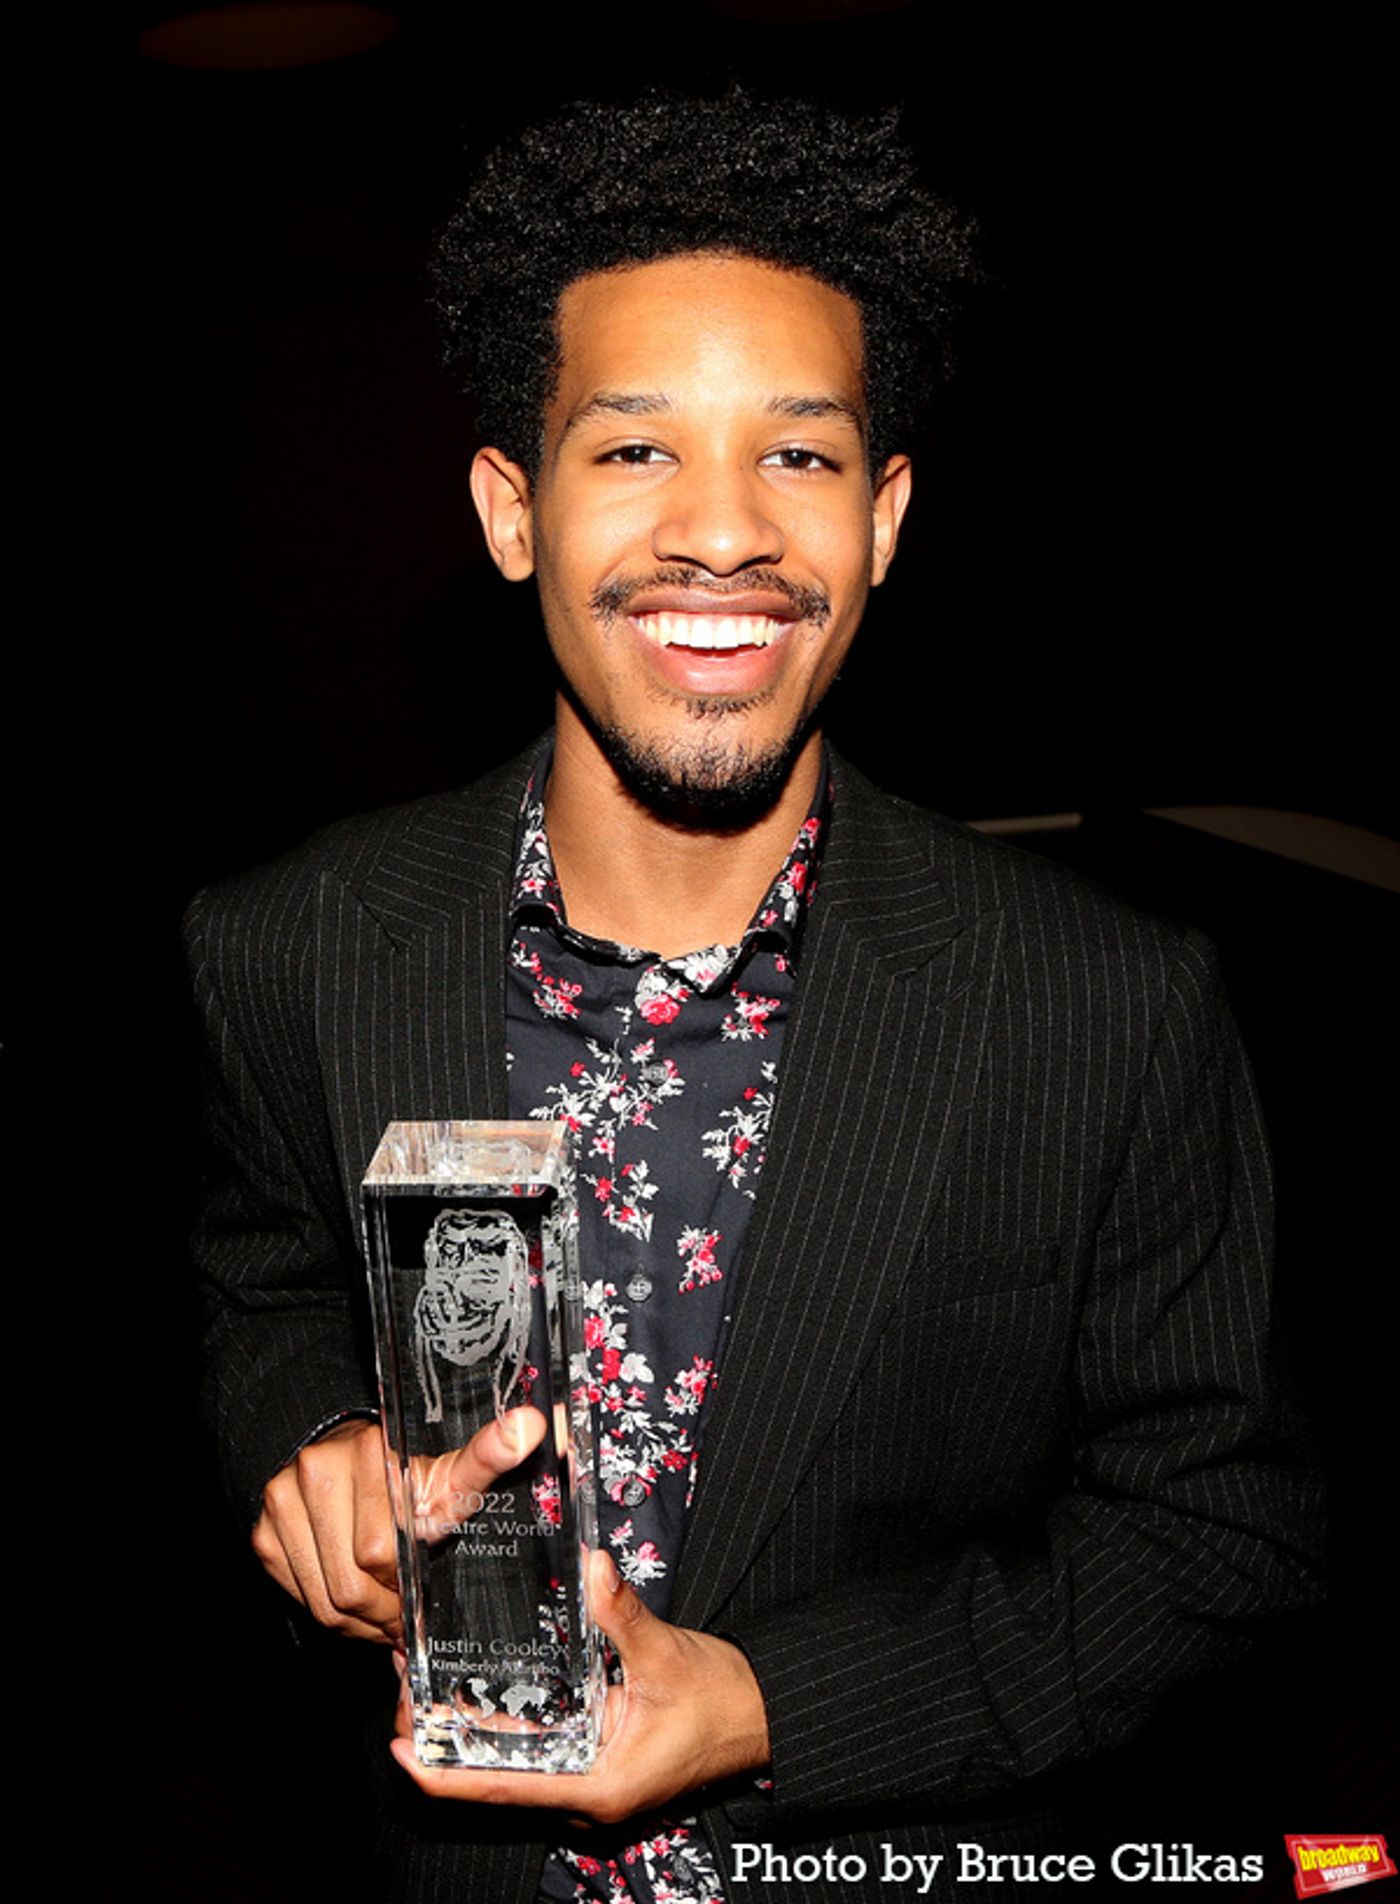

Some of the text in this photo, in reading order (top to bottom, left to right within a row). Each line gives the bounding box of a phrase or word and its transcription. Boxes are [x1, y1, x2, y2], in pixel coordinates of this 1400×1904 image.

[451, 1492, 515, 1514] 2022
[428, 1520, 555, 1537] eatre World
[454, 1539, 518, 1557] Award
[427, 1636, 563, 1660] Justin Cooley
[431, 1658, 499, 1676] Kimberly
